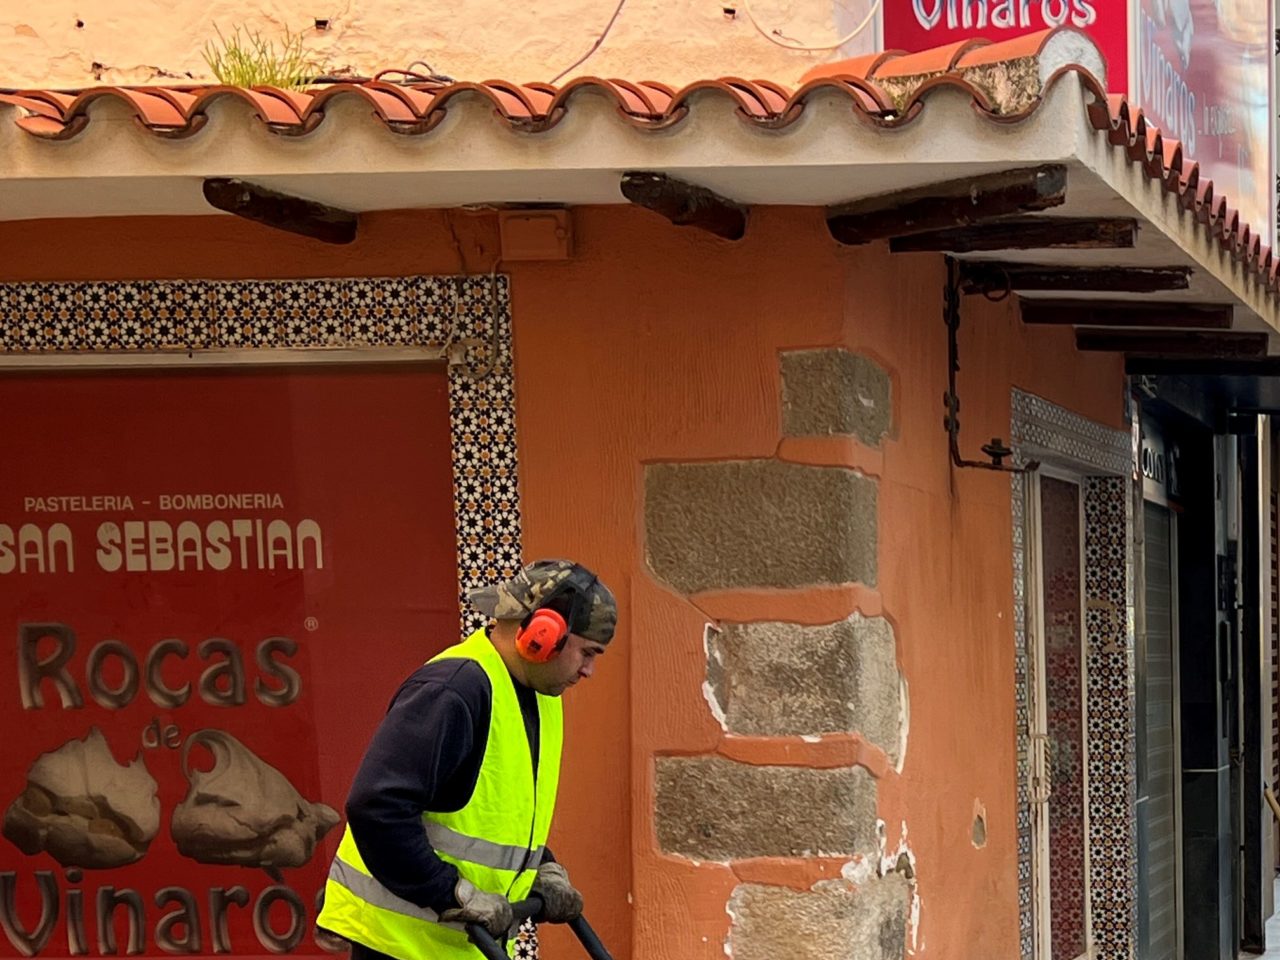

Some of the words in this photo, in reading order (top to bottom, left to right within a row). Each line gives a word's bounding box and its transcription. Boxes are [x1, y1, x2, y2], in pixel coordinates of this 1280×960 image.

[25, 496, 133, 512] PASTELERIA
[160, 494, 283, 510] BOMBONERIA
[0, 523, 74, 574] SAN
[97, 519, 323, 572] SEBASTIAN
[18, 622, 302, 709] Rocas
[142, 717, 181, 749] de
